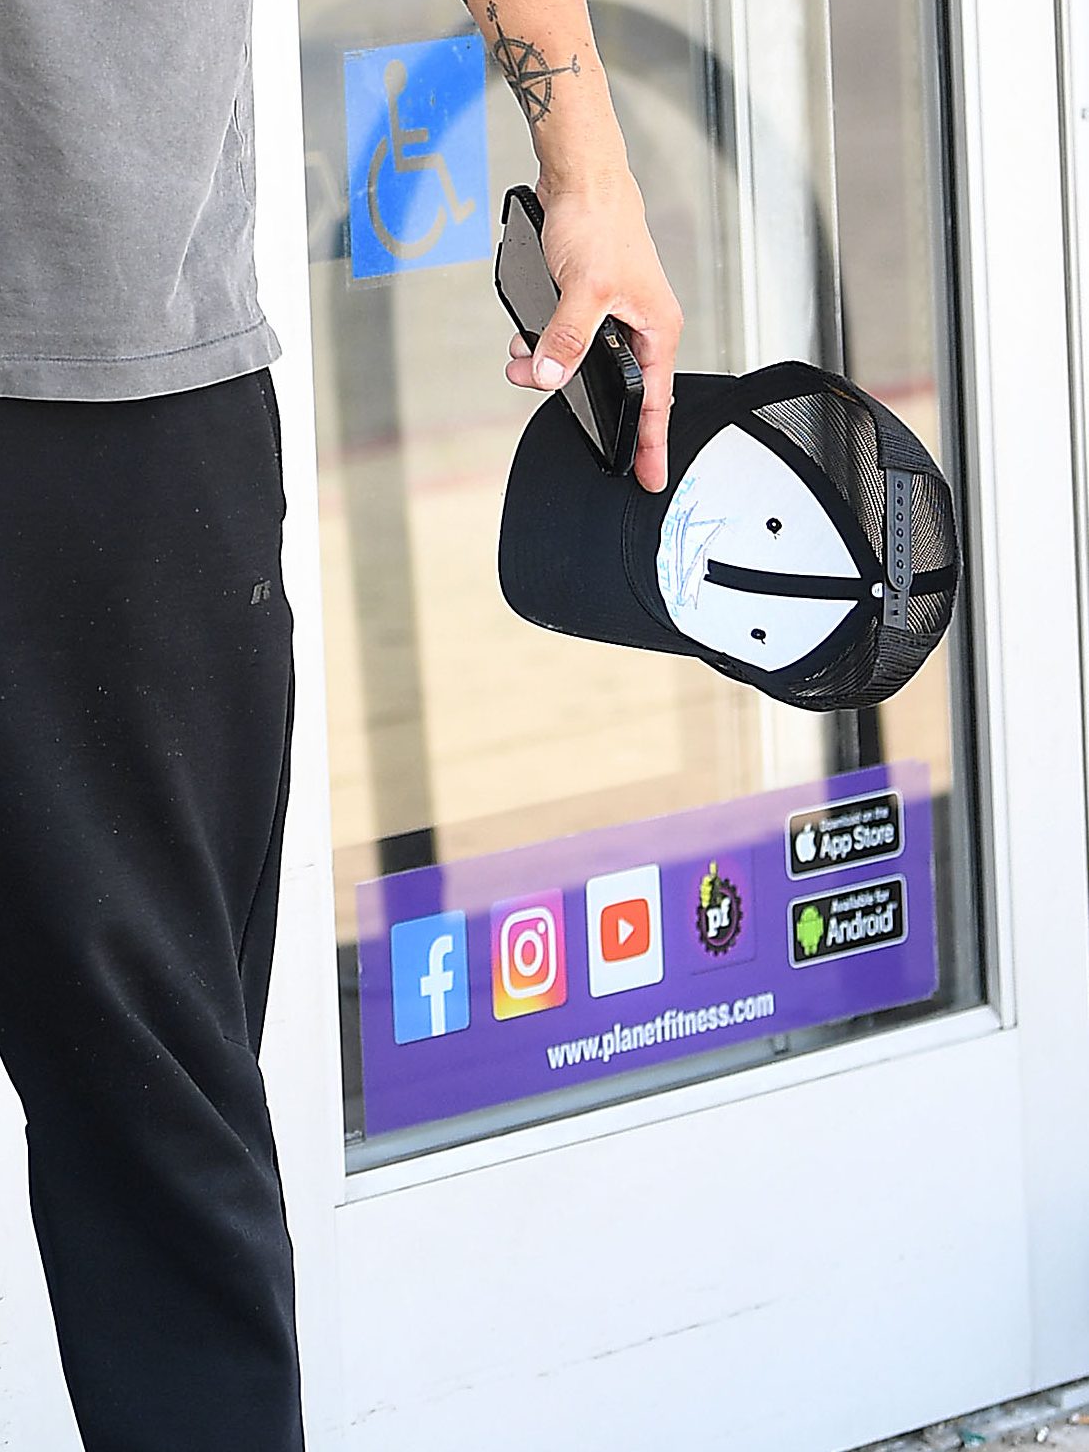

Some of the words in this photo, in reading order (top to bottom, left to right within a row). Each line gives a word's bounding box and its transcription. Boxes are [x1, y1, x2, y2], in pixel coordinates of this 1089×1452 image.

[819, 832, 853, 861] App
[853, 822, 895, 852] Store
[706, 896, 731, 938] pf
[825, 901, 894, 947] Android
[546, 991, 775, 1071] www.planetfitness.com
